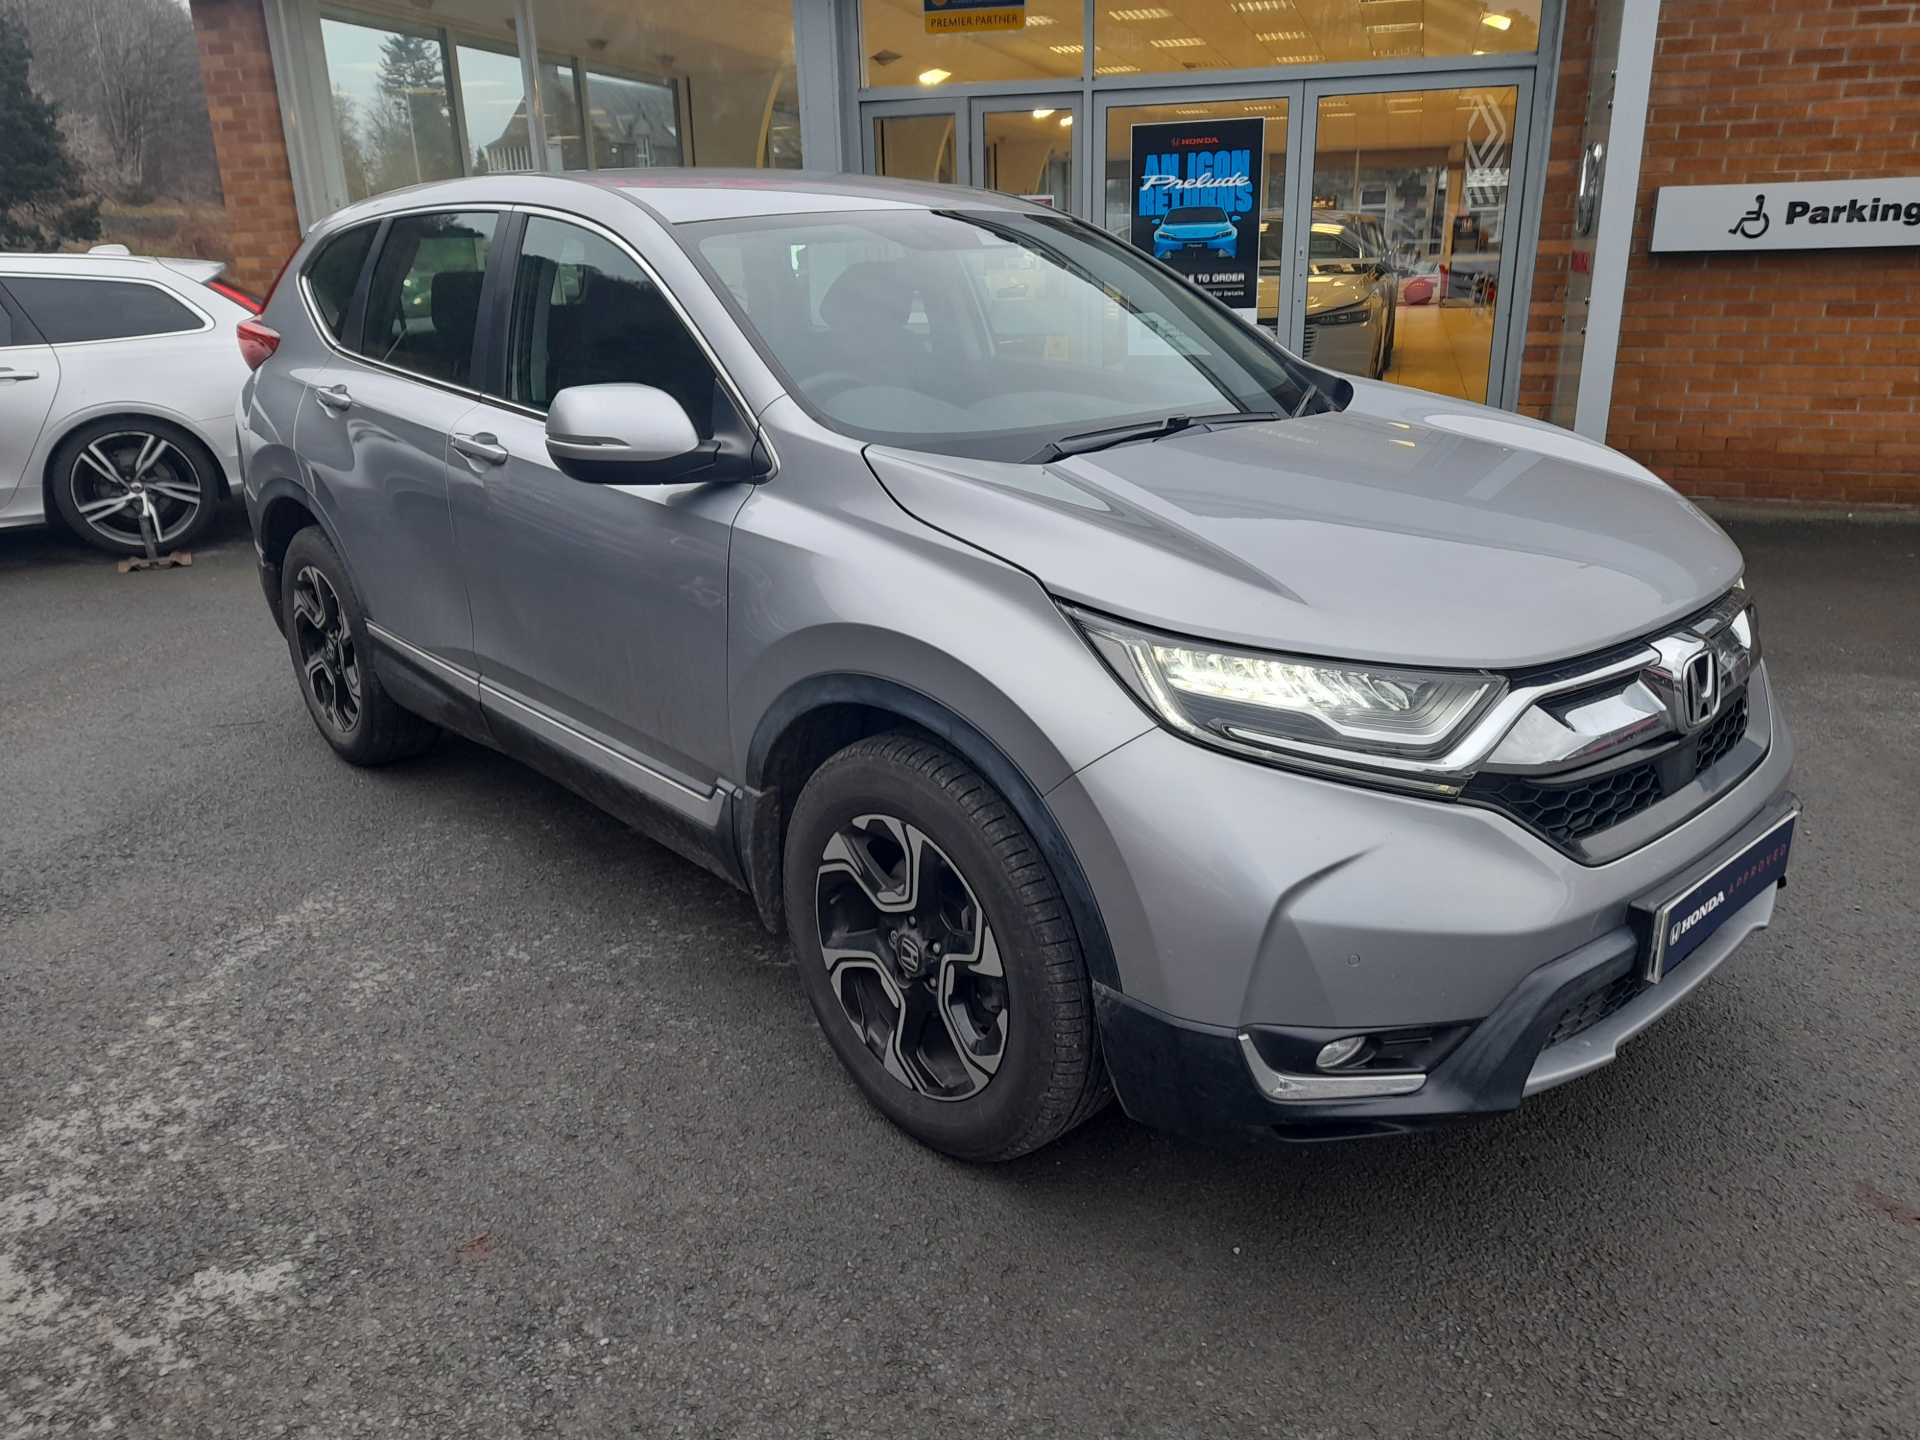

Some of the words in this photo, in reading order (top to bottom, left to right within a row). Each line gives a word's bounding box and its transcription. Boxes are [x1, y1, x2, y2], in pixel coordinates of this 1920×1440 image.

[930, 16, 974, 28] PREMIER
[976, 14, 1018, 26] PARTNER
[1181, 136, 1219, 145] HONDA
[1145, 153, 1180, 180] AN
[1187, 150, 1250, 178] ICON
[1140, 172, 1250, 191] Prelude
[1139, 181, 1253, 216] RETURNS
[1785, 197, 1920, 226] Parking
[1197, 274, 1210, 283] TO
[1211, 272, 1245, 283] ORDER
[1680, 890, 1725, 934] HONDA
